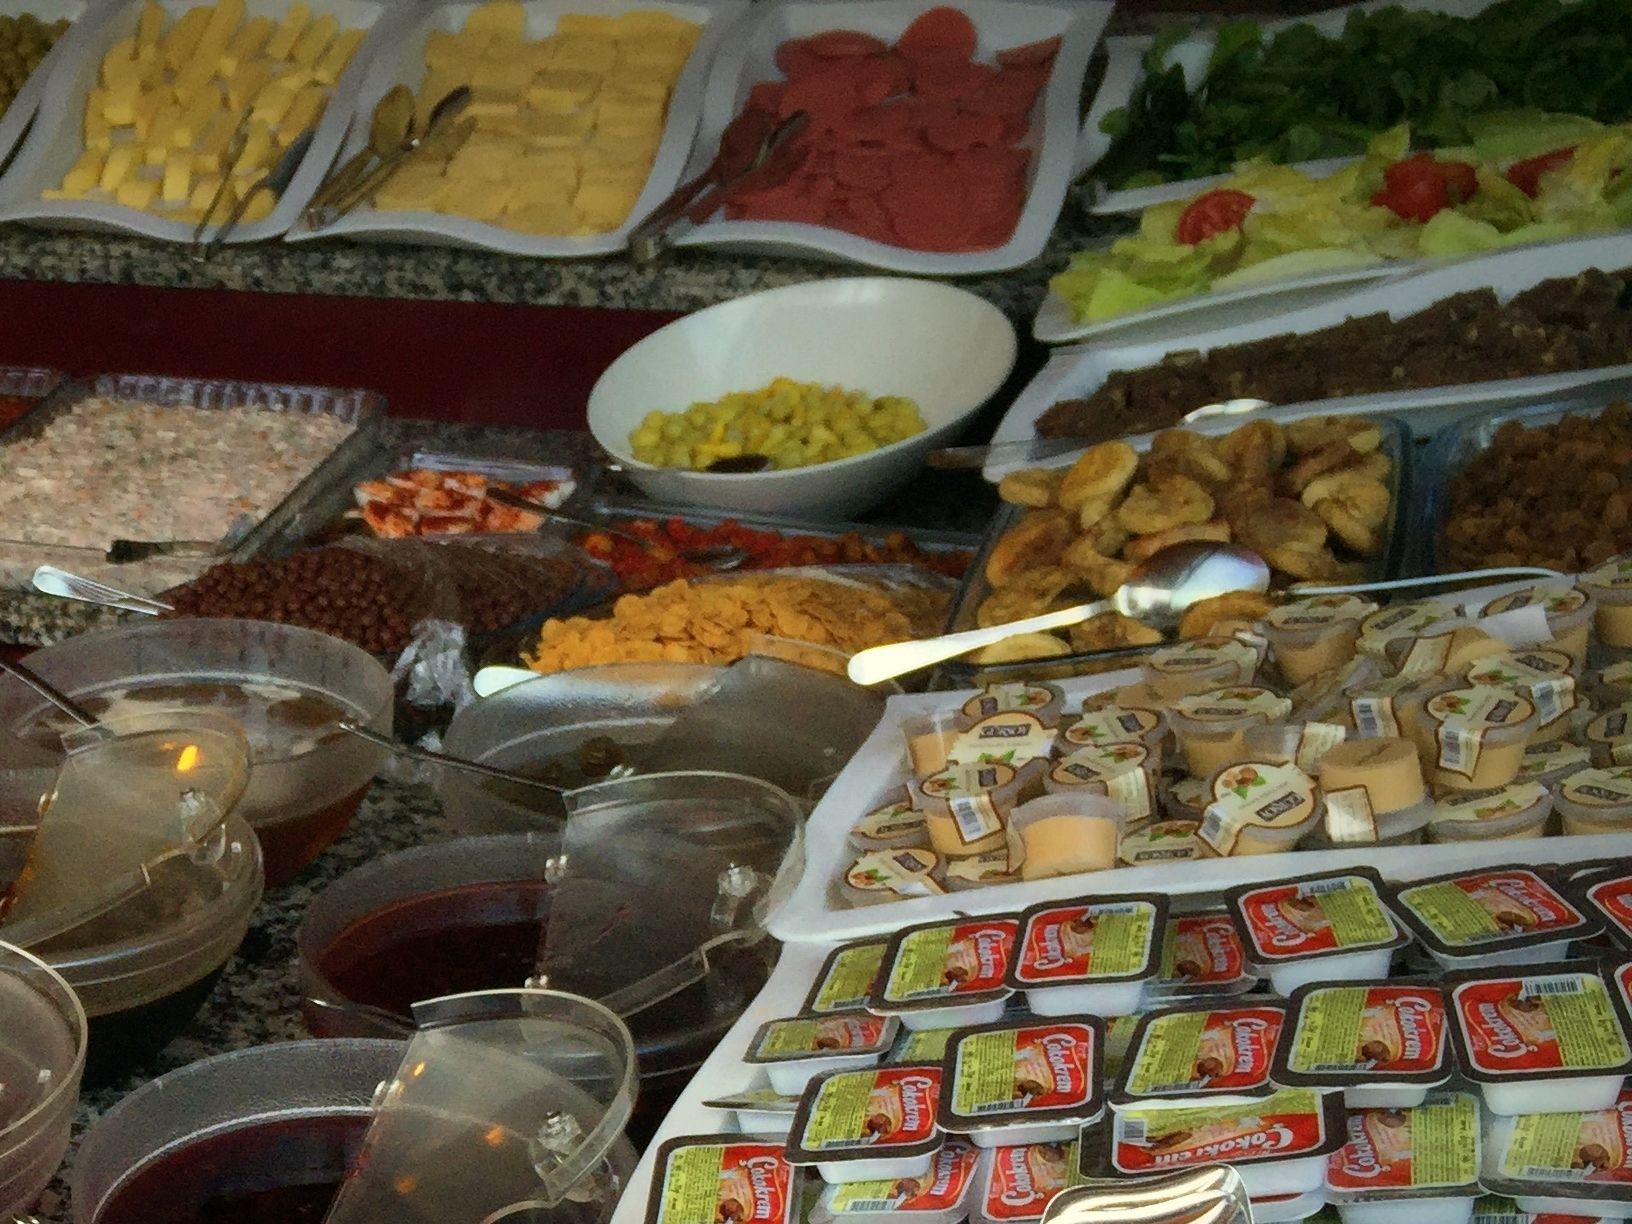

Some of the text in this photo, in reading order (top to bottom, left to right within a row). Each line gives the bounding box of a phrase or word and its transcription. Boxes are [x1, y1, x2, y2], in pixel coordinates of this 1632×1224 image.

[1386, 996, 1432, 1059] Çokokrem
[1035, 1034, 1076, 1093] Çokokrem
[893, 1076, 933, 1131] Çokokrem
[739, 1156, 778, 1219] Çokokrem
